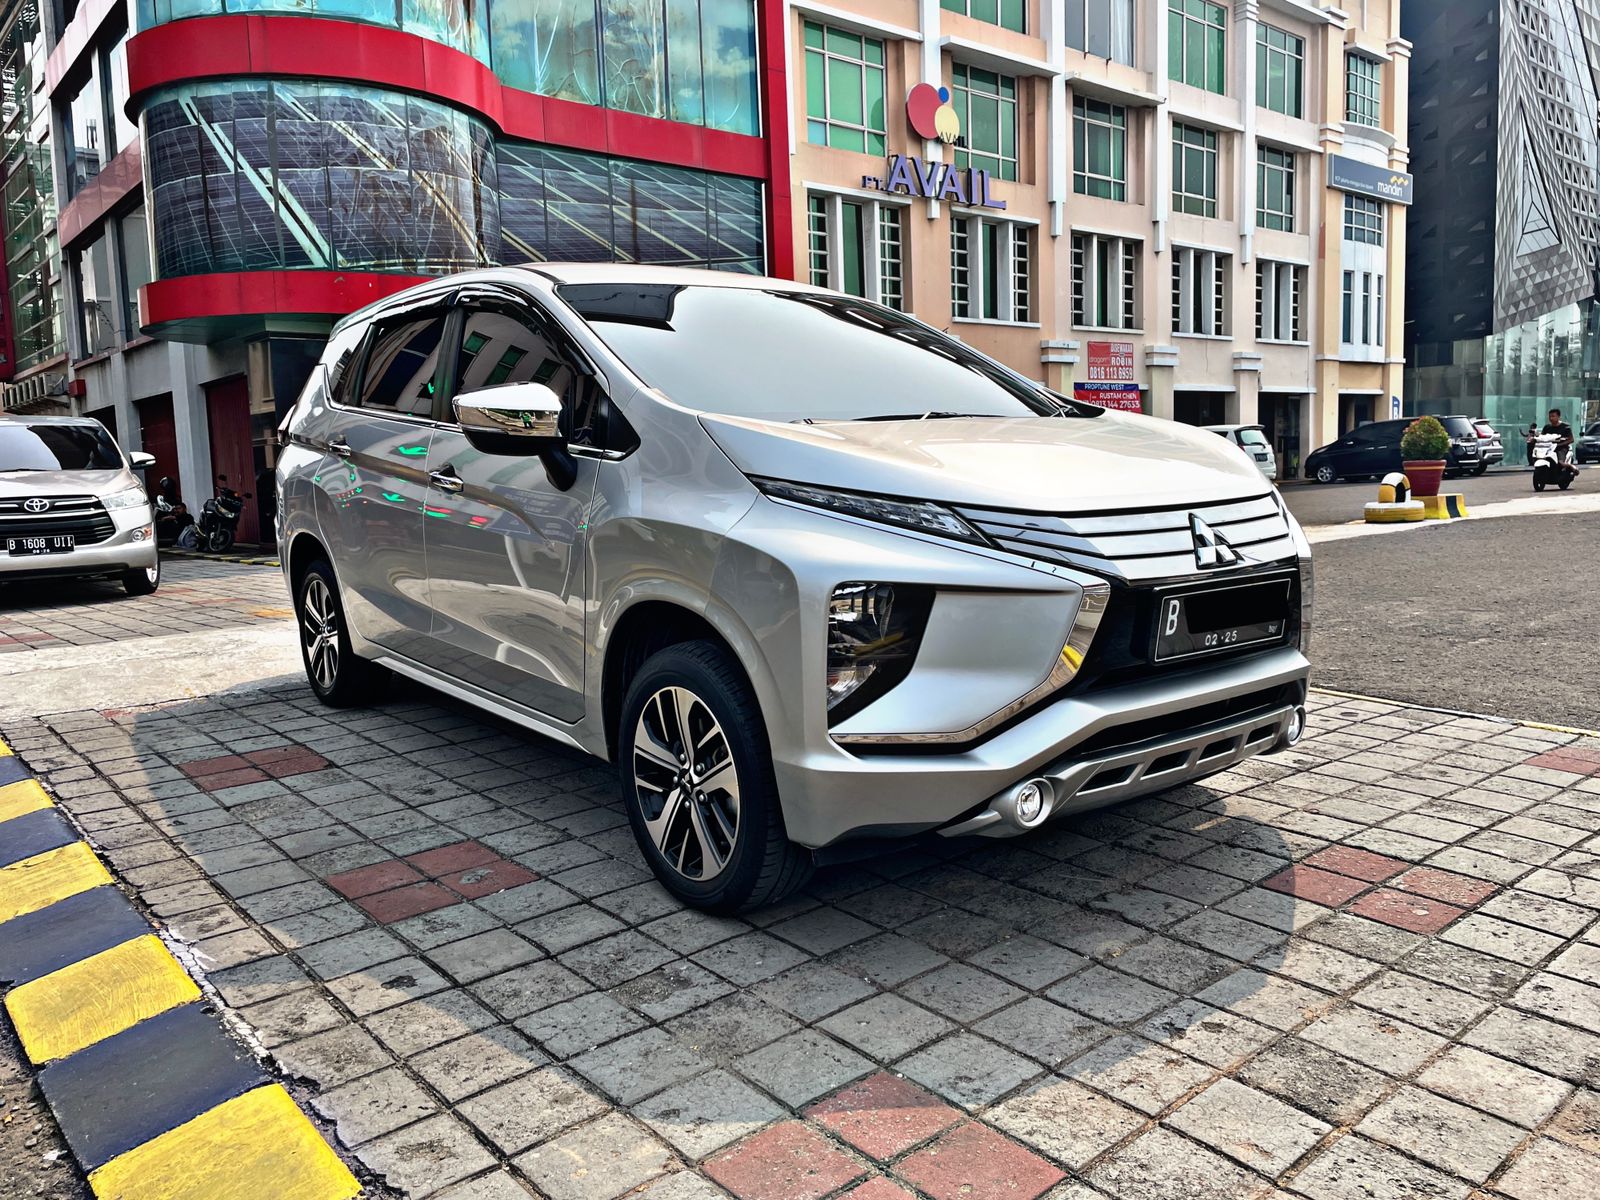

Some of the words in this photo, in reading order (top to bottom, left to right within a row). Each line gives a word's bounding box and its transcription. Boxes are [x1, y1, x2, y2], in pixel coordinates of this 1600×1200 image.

[886, 154, 1006, 210] AVAIL
[1089, 366, 1105, 379] 0816
[1106, 367, 1118, 379] 113
[9, 540, 16, 550] B
[23, 538, 46, 549] 1608
[1165, 600, 1180, 636] B
